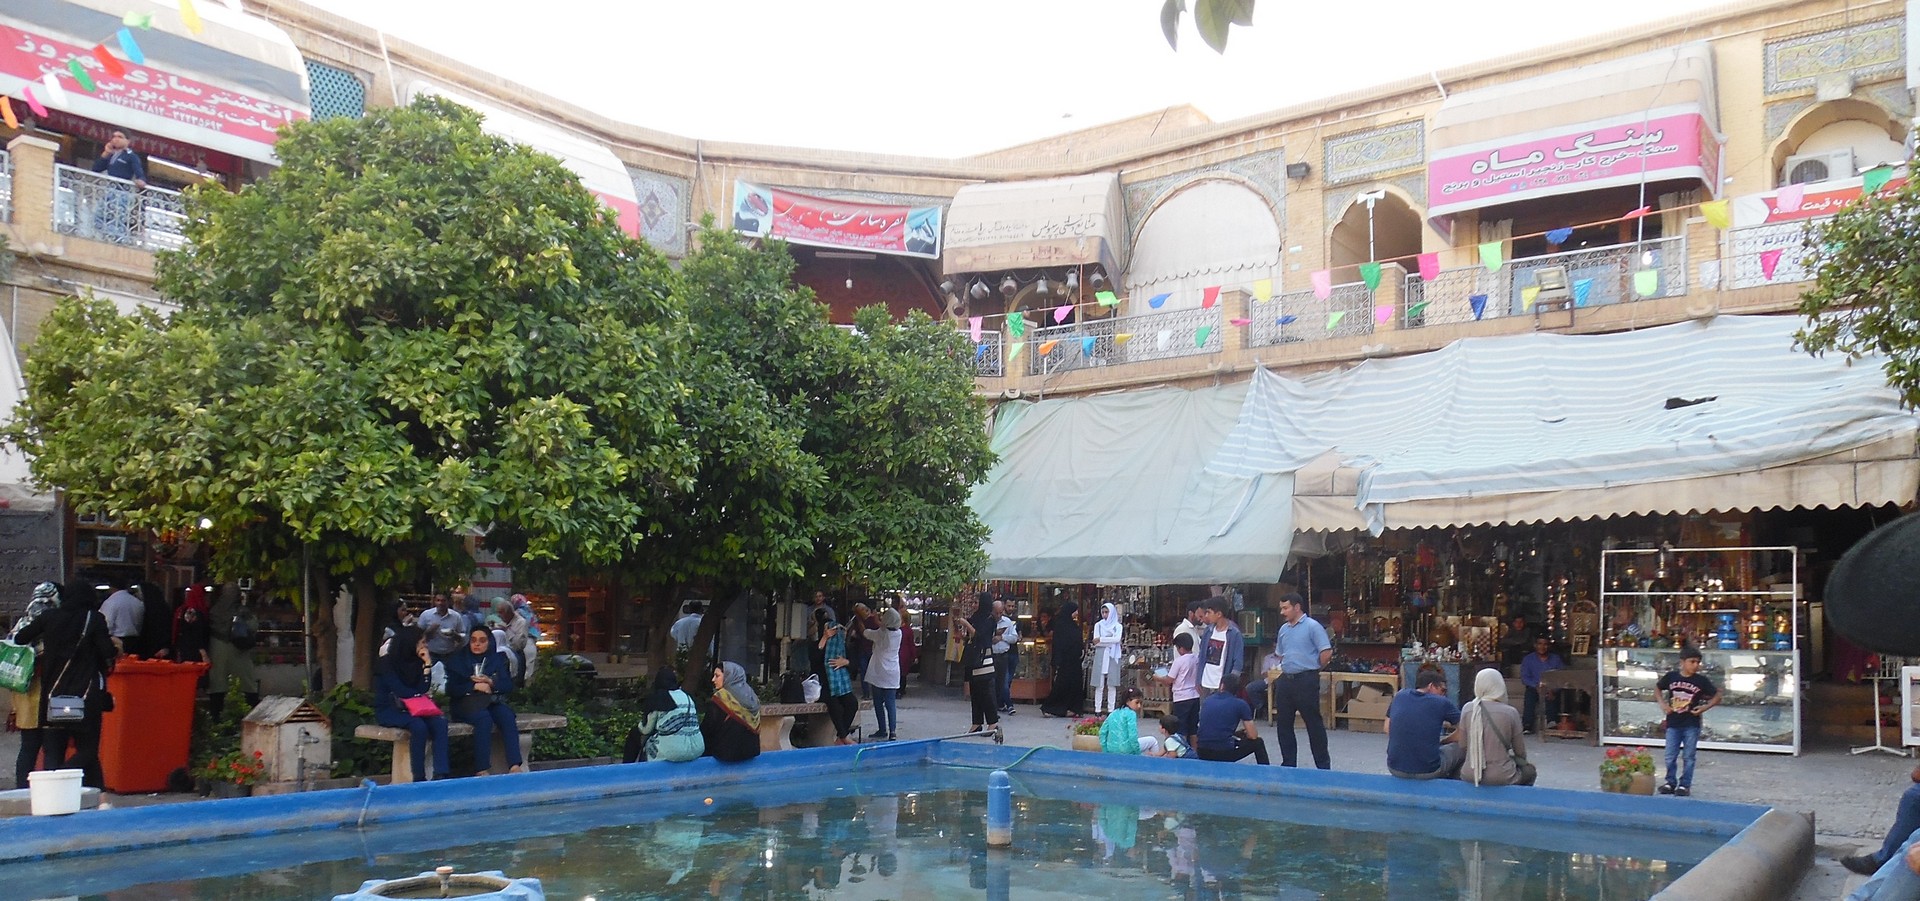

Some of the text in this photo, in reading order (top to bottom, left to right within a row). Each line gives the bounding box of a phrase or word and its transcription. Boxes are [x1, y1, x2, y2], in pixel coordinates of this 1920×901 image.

[123, 69, 202, 97] سازی
[203, 91, 292, 122] انگشتر
[1554, 129, 1664, 160] سنگ
[1471, 149, 1545, 175] ماه
[1472, 178, 1481, 188] و
[1483, 169, 1526, 184] استیل
[1443, 181, 1470, 195] برنج
[1801, 197, 1832, 211] قیمت
